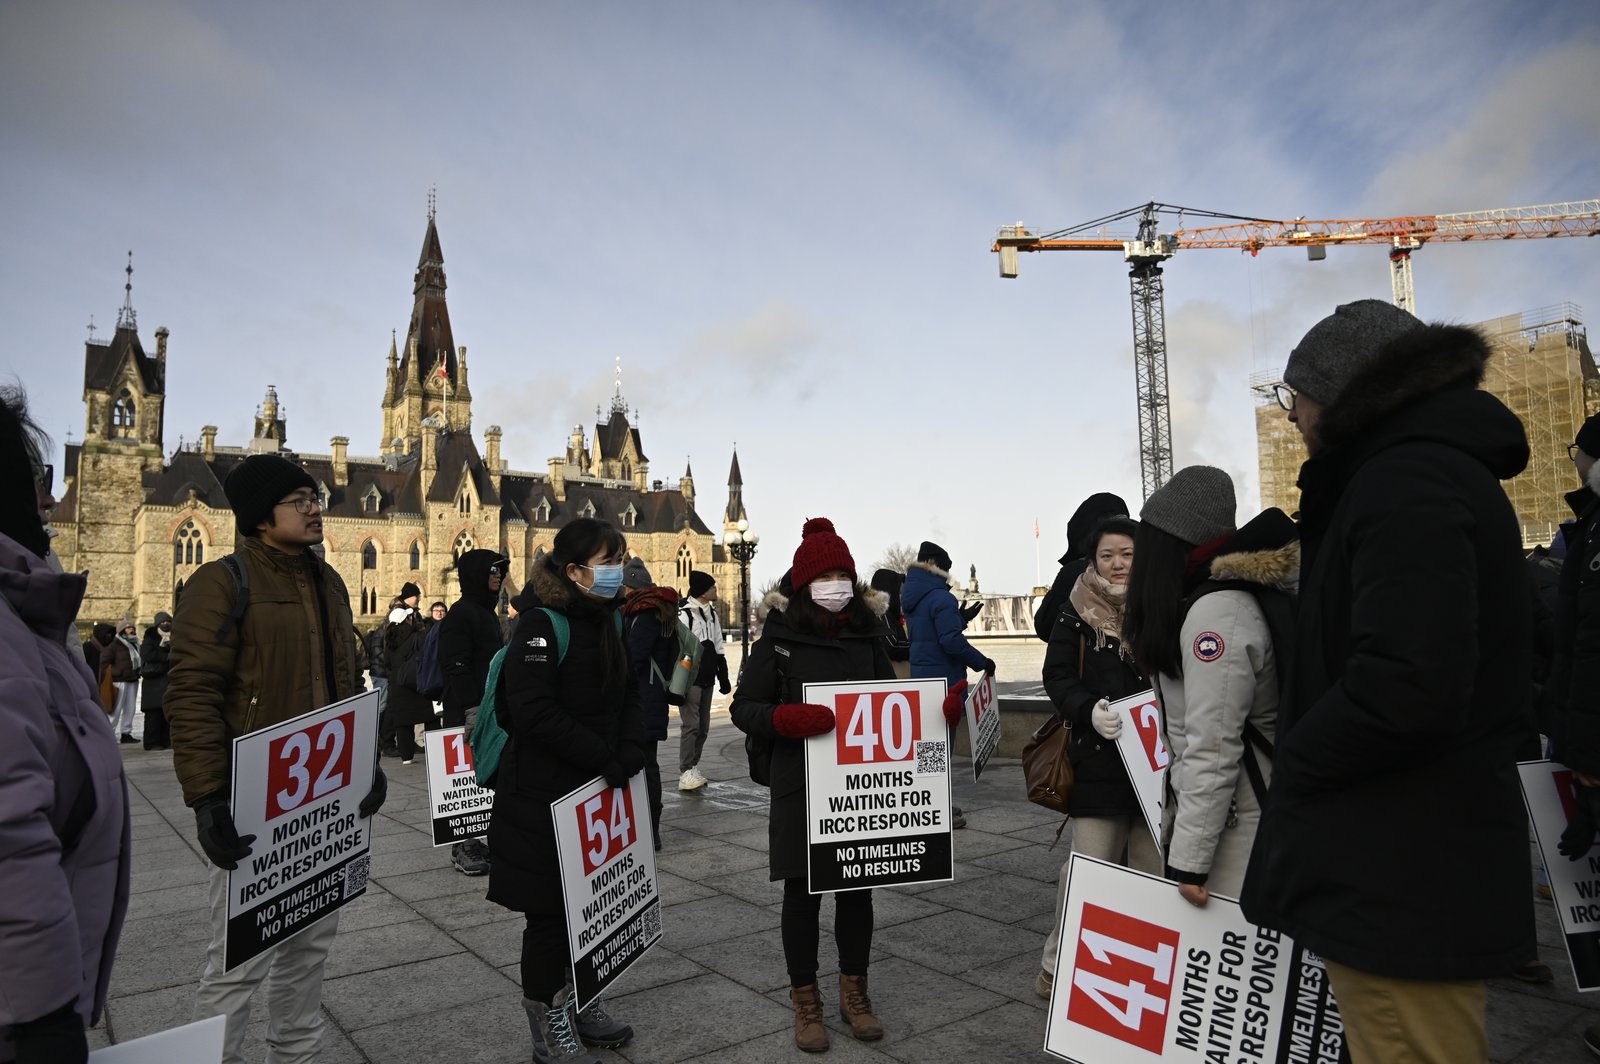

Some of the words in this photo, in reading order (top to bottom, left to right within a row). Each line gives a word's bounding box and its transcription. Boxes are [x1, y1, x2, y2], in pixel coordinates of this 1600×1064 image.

[845, 692, 913, 761] 40
[1140, 704, 1169, 768] 2
[276, 718, 346, 811] 32
[451, 734, 471, 773] 1
[437, 801, 460, 814] IRCC
[461, 795, 493, 810] RESPO
[442, 787, 484, 801] WAITING
[452, 775, 476, 788] MON
[828, 792, 896, 813] WAITING
[901, 790, 931, 807] FOR
[846, 770, 913, 790] MONTHS
[252, 829, 322, 876] WAITING
[326, 813, 356, 840] FOR
[272, 799, 341, 845] MONTHS
[448, 818, 461, 828] NO
[453, 826, 465, 836] NO
[466, 822, 490, 834] RESU
[584, 787, 631, 868] 54
[819, 817, 855, 835] IRCC
[858, 810, 941, 832] RESPONSE
[240, 871, 279, 905] IRCC
[281, 828, 363, 885] RESPONSE
[591, 852, 634, 895] MONTHS
[836, 847, 855, 862] NO
[858, 841, 926, 860] TIMELINES
[842, 864, 862, 879] NO
[864, 858, 921, 877] RESULTS
[256, 904, 276, 926] NO
[279, 865, 346, 913] TIMELINES
[261, 920, 281, 941] NO
[284, 887, 340, 930] RESULTS
[578, 921, 602, 950] IRCC
[603, 878, 653, 931] RESPONSE
[582, 882, 626, 924] WAITING
[627, 864, 646, 892] FOR
[591, 950, 605, 969] NO
[605, 916, 642, 961] TIMELINE
[597, 963, 610, 982] NO
[611, 933, 645, 970] RESULTS
[1217, 930, 1247, 981] FOR
[1073, 927, 1175, 1031] 41
[1175, 947, 1212, 1051] MONTHS
[1240, 925, 1281, 1064] RESPONSE
[1204, 984, 1240, 1064] AITING
